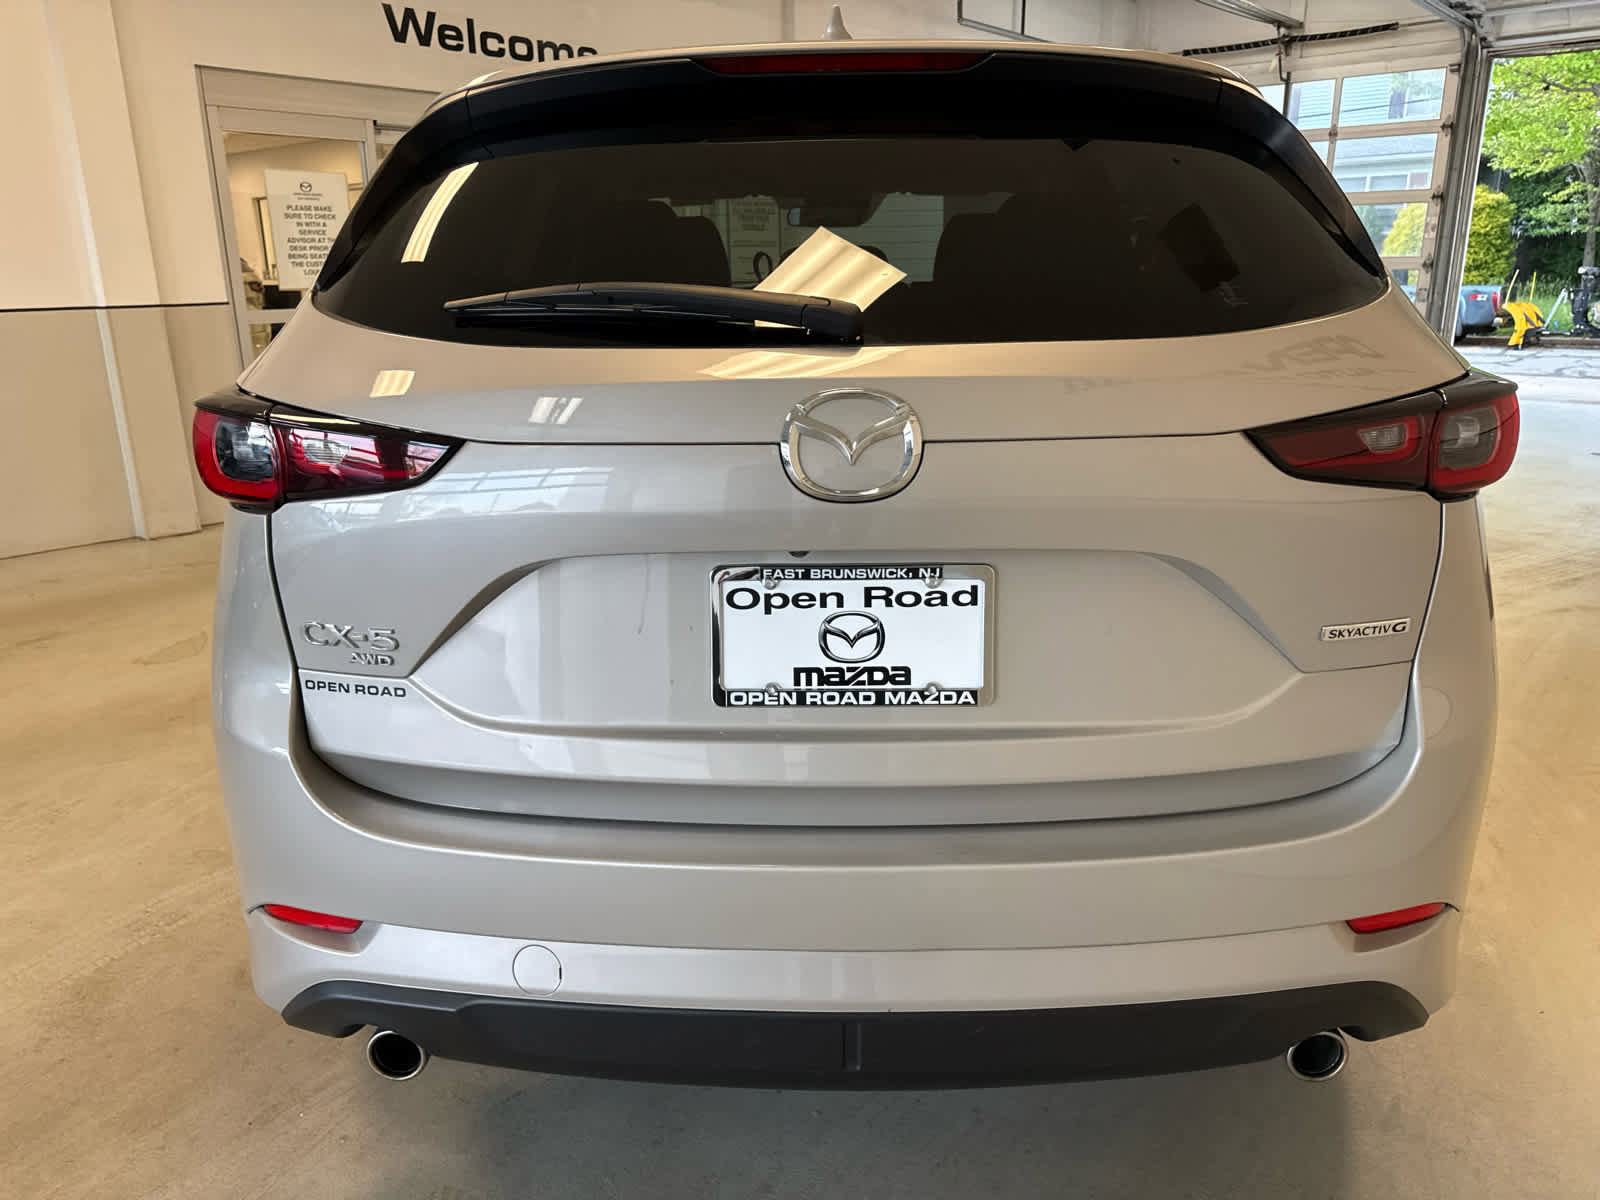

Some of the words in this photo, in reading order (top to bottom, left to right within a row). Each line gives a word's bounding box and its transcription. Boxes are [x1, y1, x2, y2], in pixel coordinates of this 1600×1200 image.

[286, 204, 313, 212] PLEASE
[283, 212, 302, 220] SURE
[810, 568, 912, 579] BRUNSWICK,
[919, 568, 940, 577] NJ
[726, 587, 844, 615] Open
[864, 585, 978, 608] Road
[304, 622, 400, 651] CX-5
[351, 652, 394, 666] AWD
[305, 680, 350, 693] OPEN
[354, 684, 406, 698] ROAD
[730, 691, 797, 705] OPEN
[806, 691, 876, 705] ROAD
[884, 691, 976, 705] MAZDA
